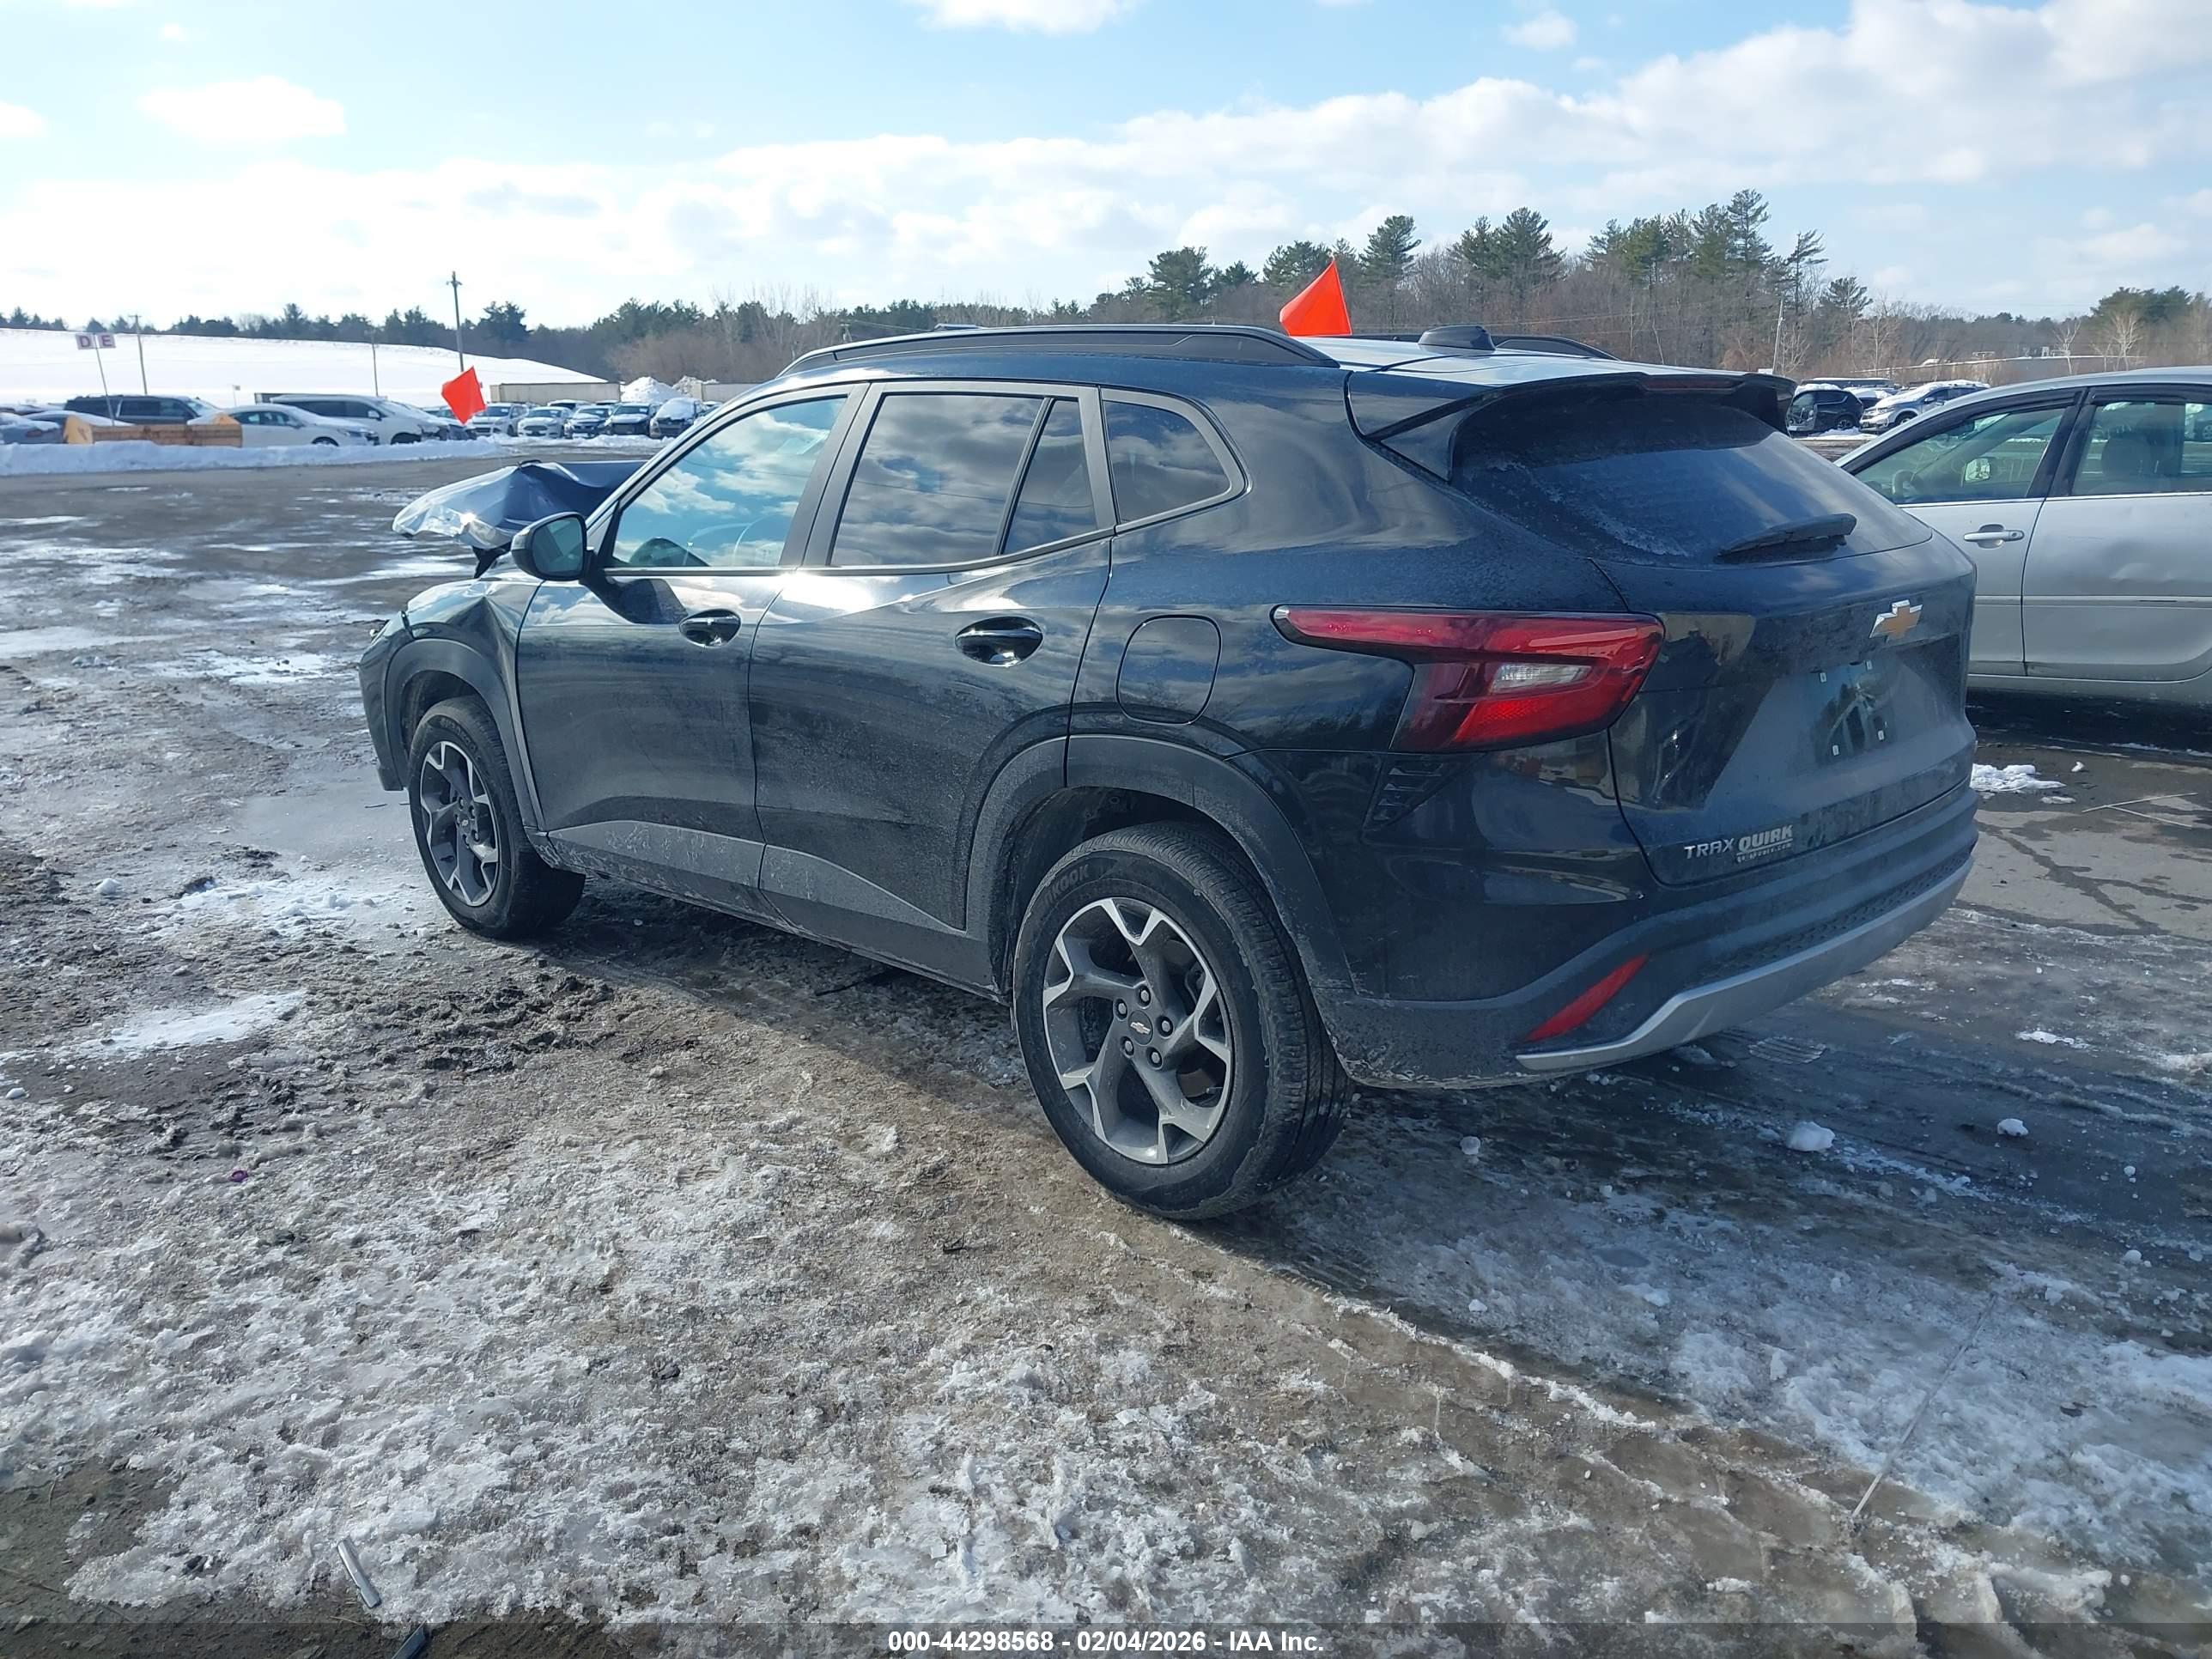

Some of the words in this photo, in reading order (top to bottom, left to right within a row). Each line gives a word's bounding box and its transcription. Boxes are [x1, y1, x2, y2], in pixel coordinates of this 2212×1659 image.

[79, 335, 91, 348] D
[101, 334, 112, 347] E
[1737, 824, 1793, 853] QUIRK
[1684, 837, 1735, 860] TRAX
